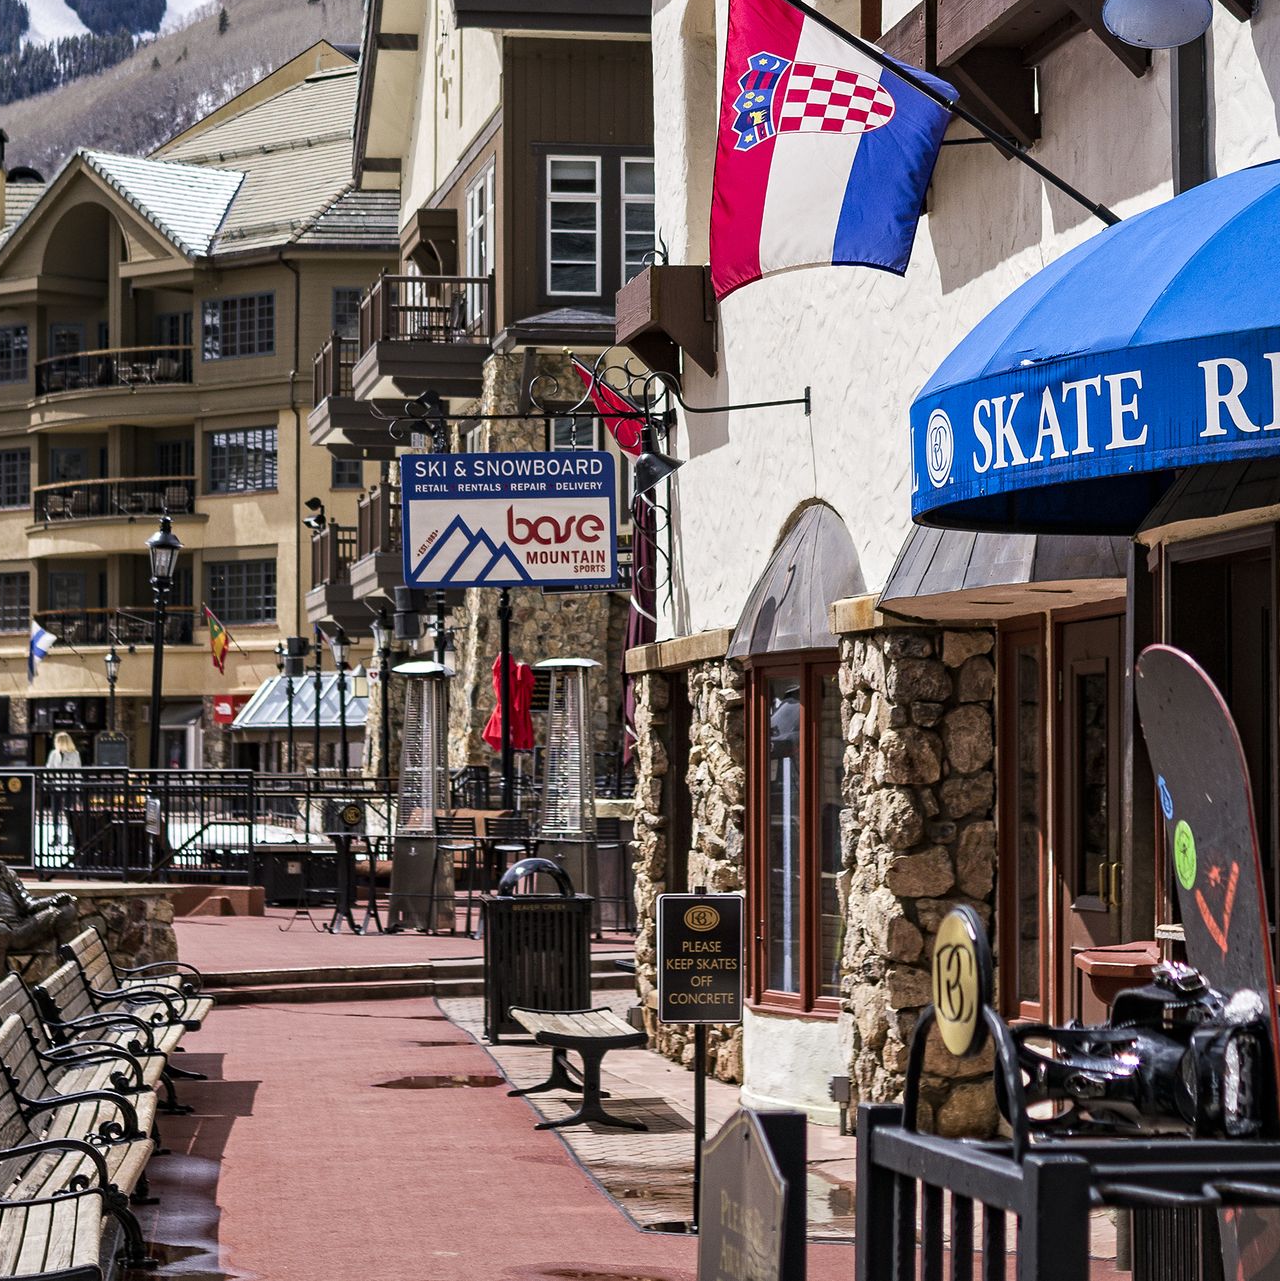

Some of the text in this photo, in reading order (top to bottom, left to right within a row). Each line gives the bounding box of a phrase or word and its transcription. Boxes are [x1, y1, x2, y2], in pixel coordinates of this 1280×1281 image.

[971, 369, 1149, 474] SKATE
[415, 458, 603, 478] SKI & SNOWBOARD
[415, 481, 603, 493] RETAIL RENTALS REPAIR DELIVERY
[506, 503, 605, 546] base
[526, 550, 606, 565] MOUNTAIN
[573, 565, 606, 574] SPORTS
[682, 941, 721, 953] PLEASE
[666, 958, 737, 970] KEEP SKATES
[690, 975, 713, 987] OFF
[669, 993, 735, 1005] CONCRETE
